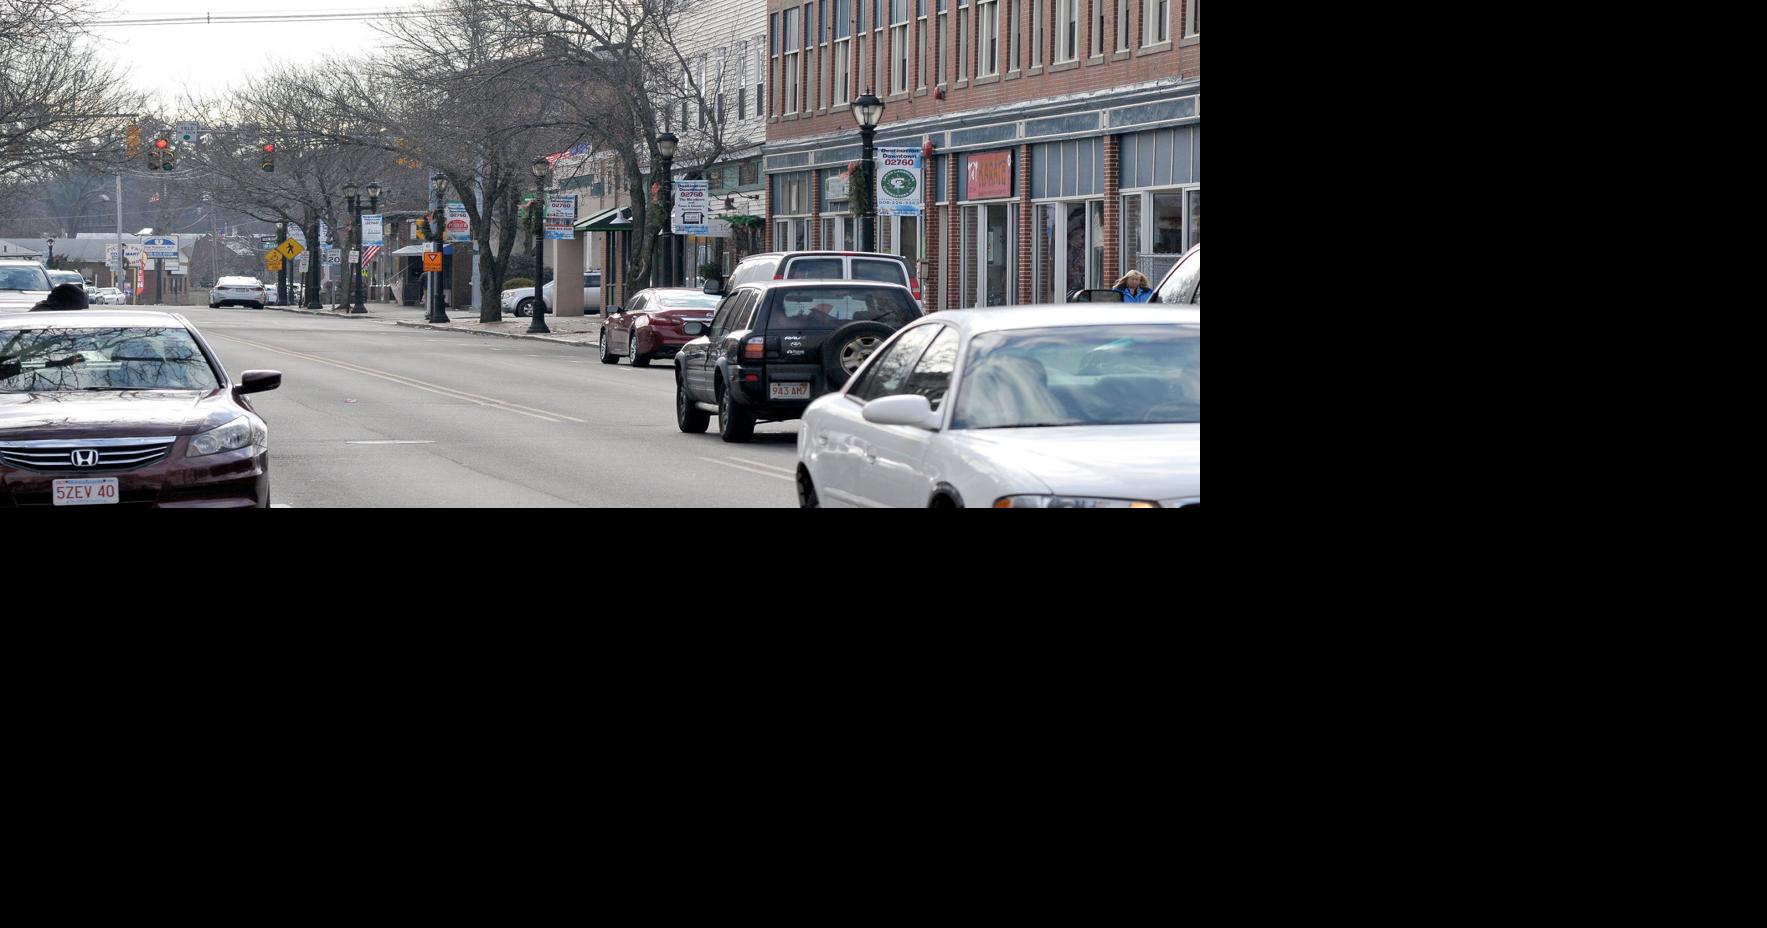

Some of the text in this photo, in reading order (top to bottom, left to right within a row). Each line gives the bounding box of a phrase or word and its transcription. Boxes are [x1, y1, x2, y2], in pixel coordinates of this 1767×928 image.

[772, 386, 789, 395] 943
[56, 484, 115, 499] 5ZEV 40
